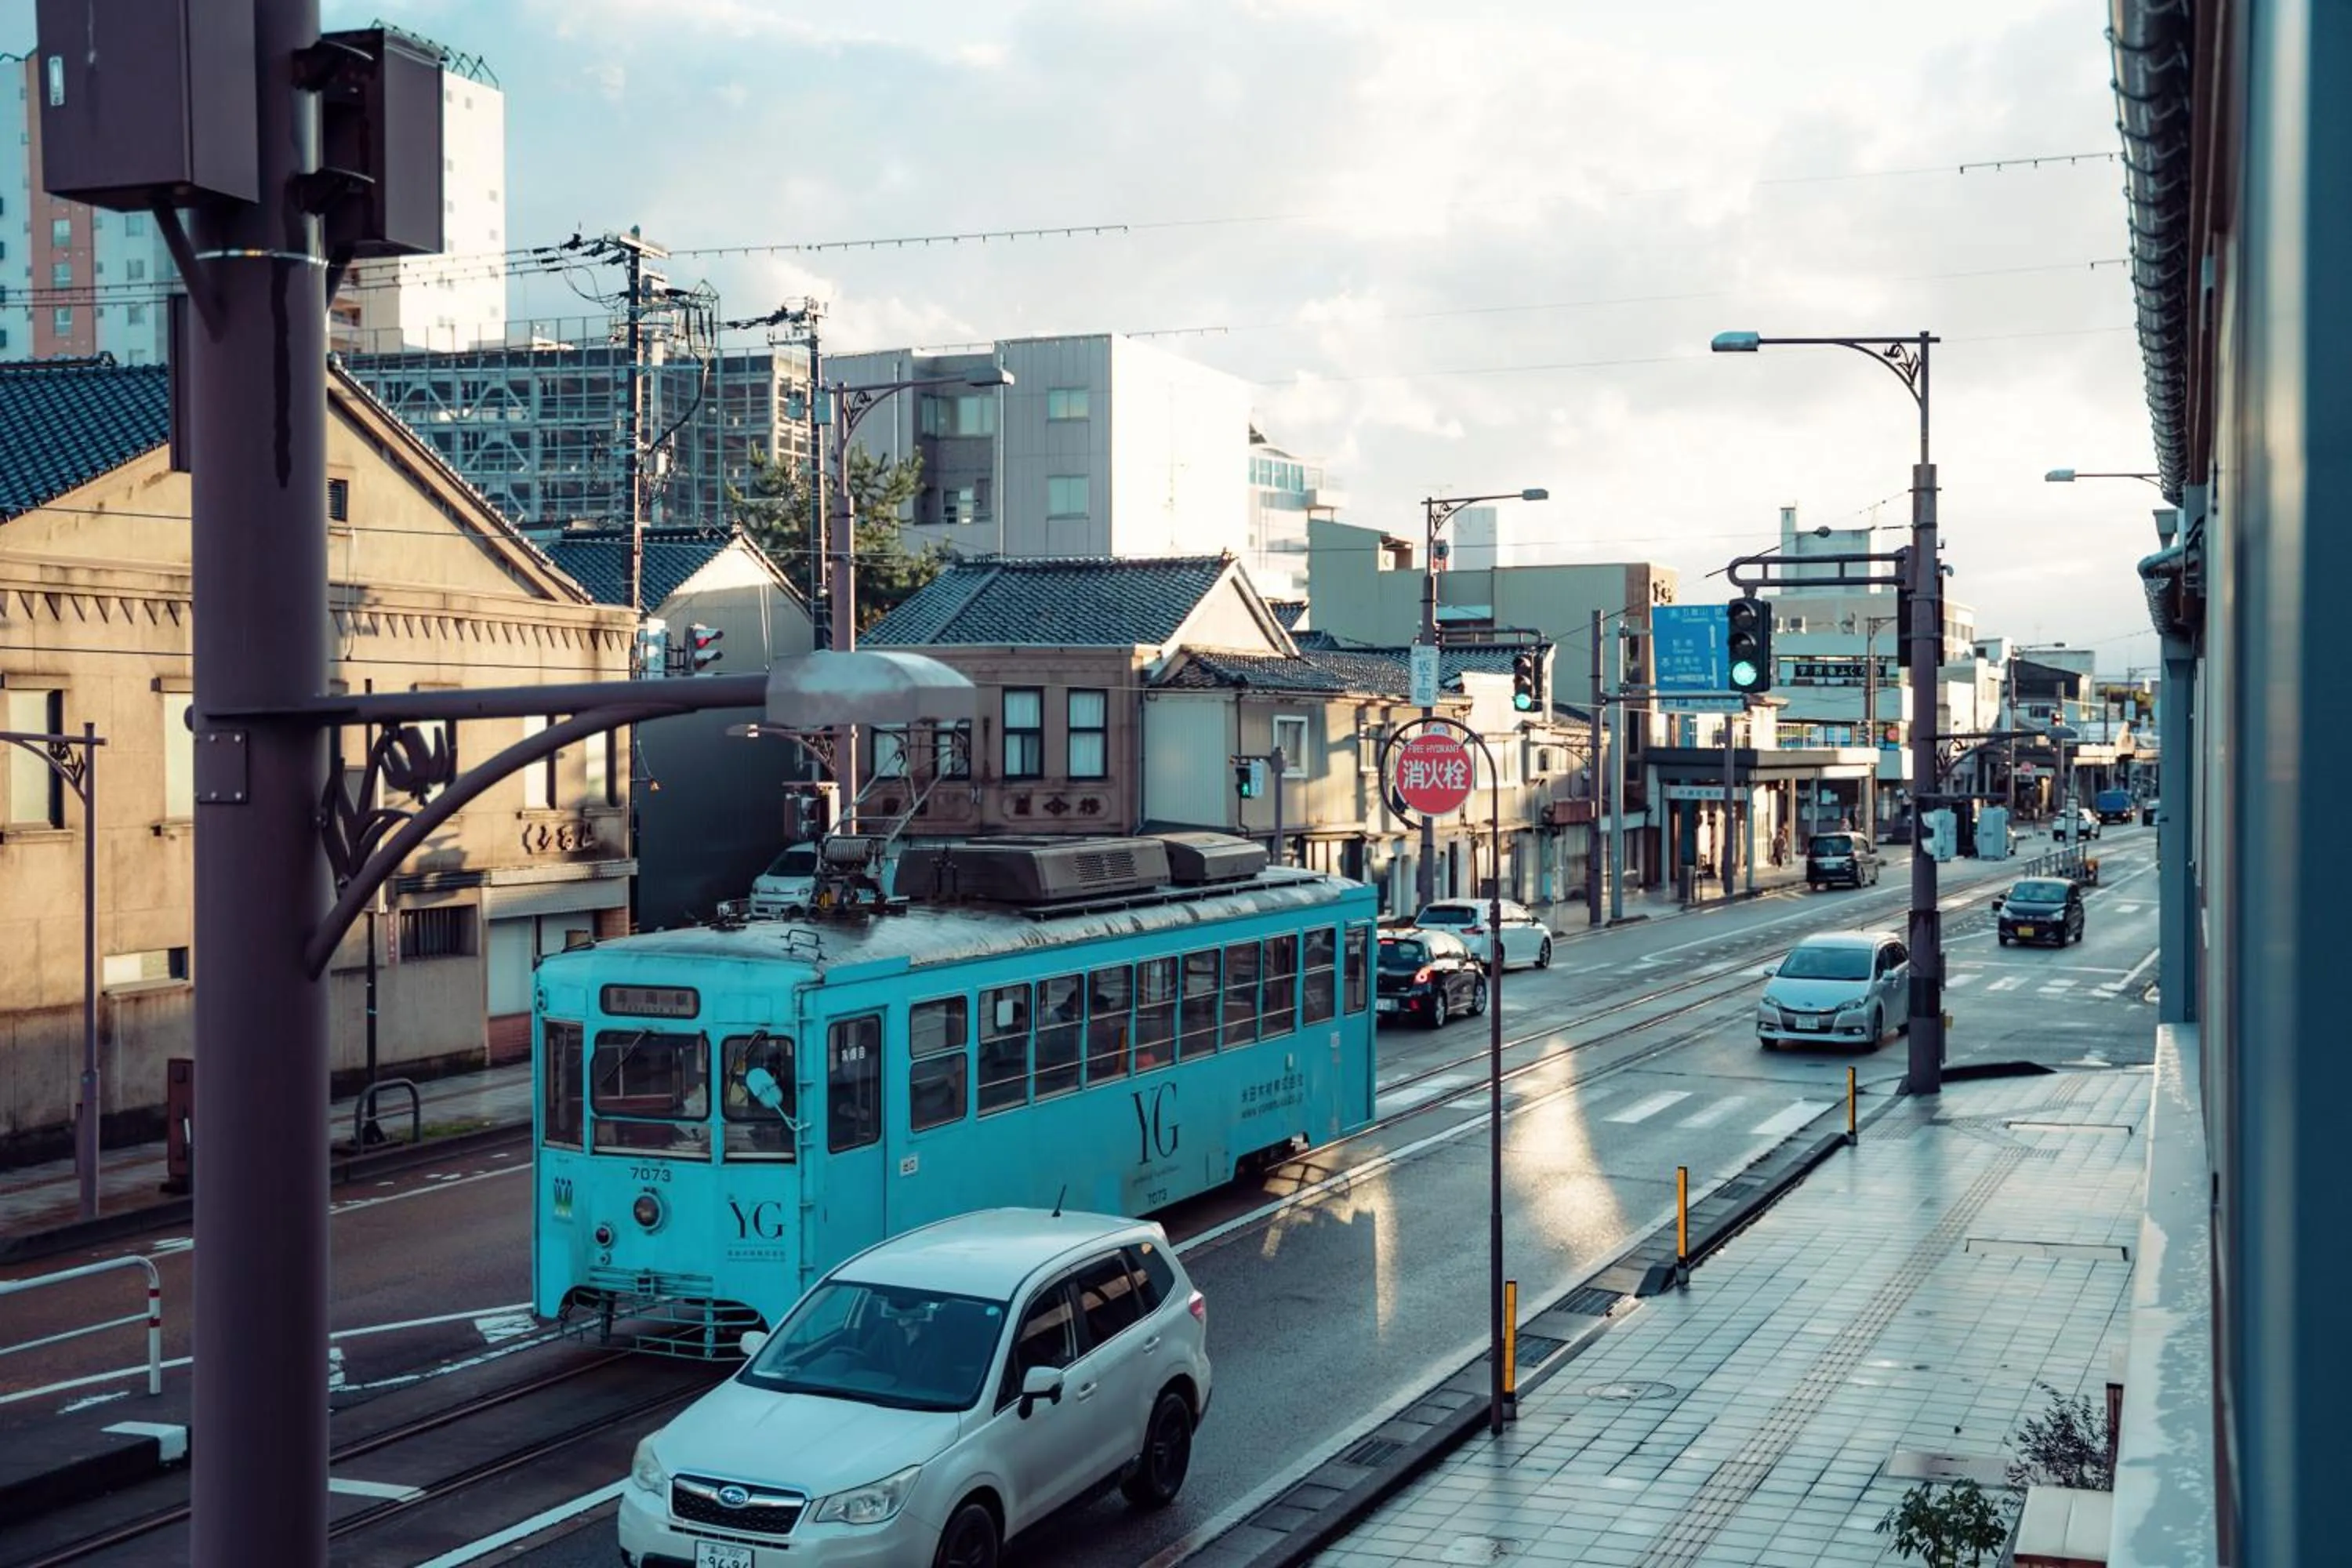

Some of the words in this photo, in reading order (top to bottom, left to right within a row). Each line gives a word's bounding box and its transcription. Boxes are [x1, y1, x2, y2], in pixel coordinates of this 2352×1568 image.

[1407, 744, 1425, 753] FIRE
[1426, 744, 1460, 753] HYDRANT
[1403, 758, 1468, 790] 消火栓
[1131, 1081, 1180, 1165] YG
[629, 1167, 672, 1182] 7073
[728, 1200, 786, 1240] YG
